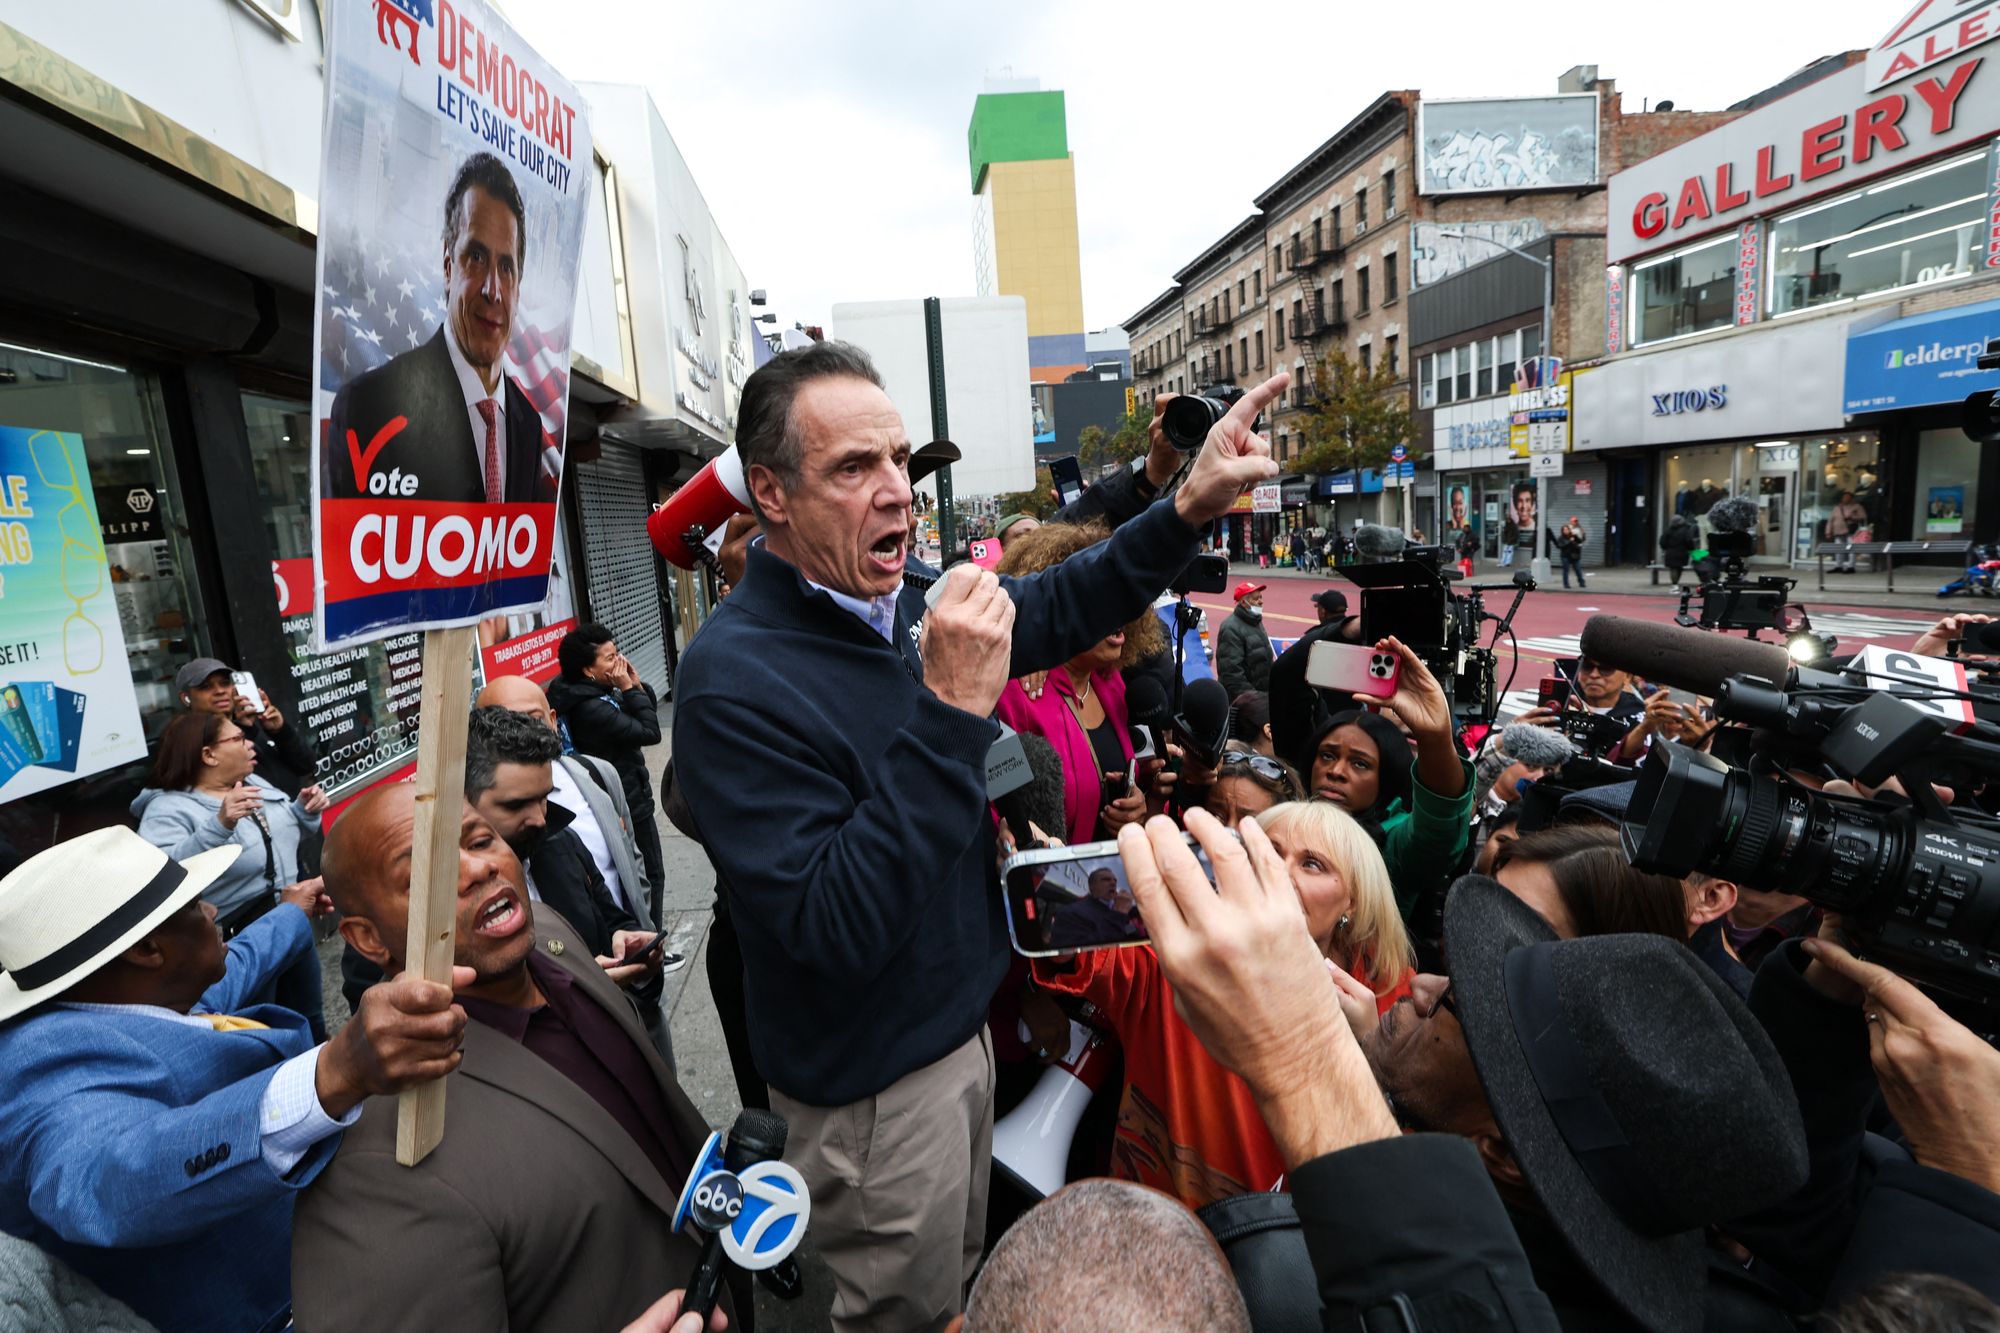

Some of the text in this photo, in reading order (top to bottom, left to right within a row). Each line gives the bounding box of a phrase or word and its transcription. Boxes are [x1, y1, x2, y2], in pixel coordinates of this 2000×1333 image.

[1879, 6, 2000, 83] ALE
[438, 0, 575, 161] DEMOCRAT
[437, 75, 571, 195] LET'S SAVE OUR CITY
[1632, 57, 1984, 241] GALLERY
[1738, 223, 1757, 328] FURNITURE
[346, 415, 419, 496] Vote
[350, 513, 538, 583] CUOMO
[398, 633, 419, 646] CHOICE
[322, 653, 350, 669] HEALTH
[350, 647, 370, 660] PLAN
[389, 648, 420, 666] MEDICARE
[301, 668, 352, 694] HEALTH FIRST
[392, 662, 422, 680] MEDICAID
[320, 686, 349, 706] HEALTH
[349, 680, 368, 695] CARE
[385, 683, 411, 699] EMBLEM
[308, 699, 358, 728] DAVIS VISION
[319, 718, 354, 743] 1199 SEIU
[1925, 833, 1960, 849] 4K
[695, 1183, 742, 1218] abc
